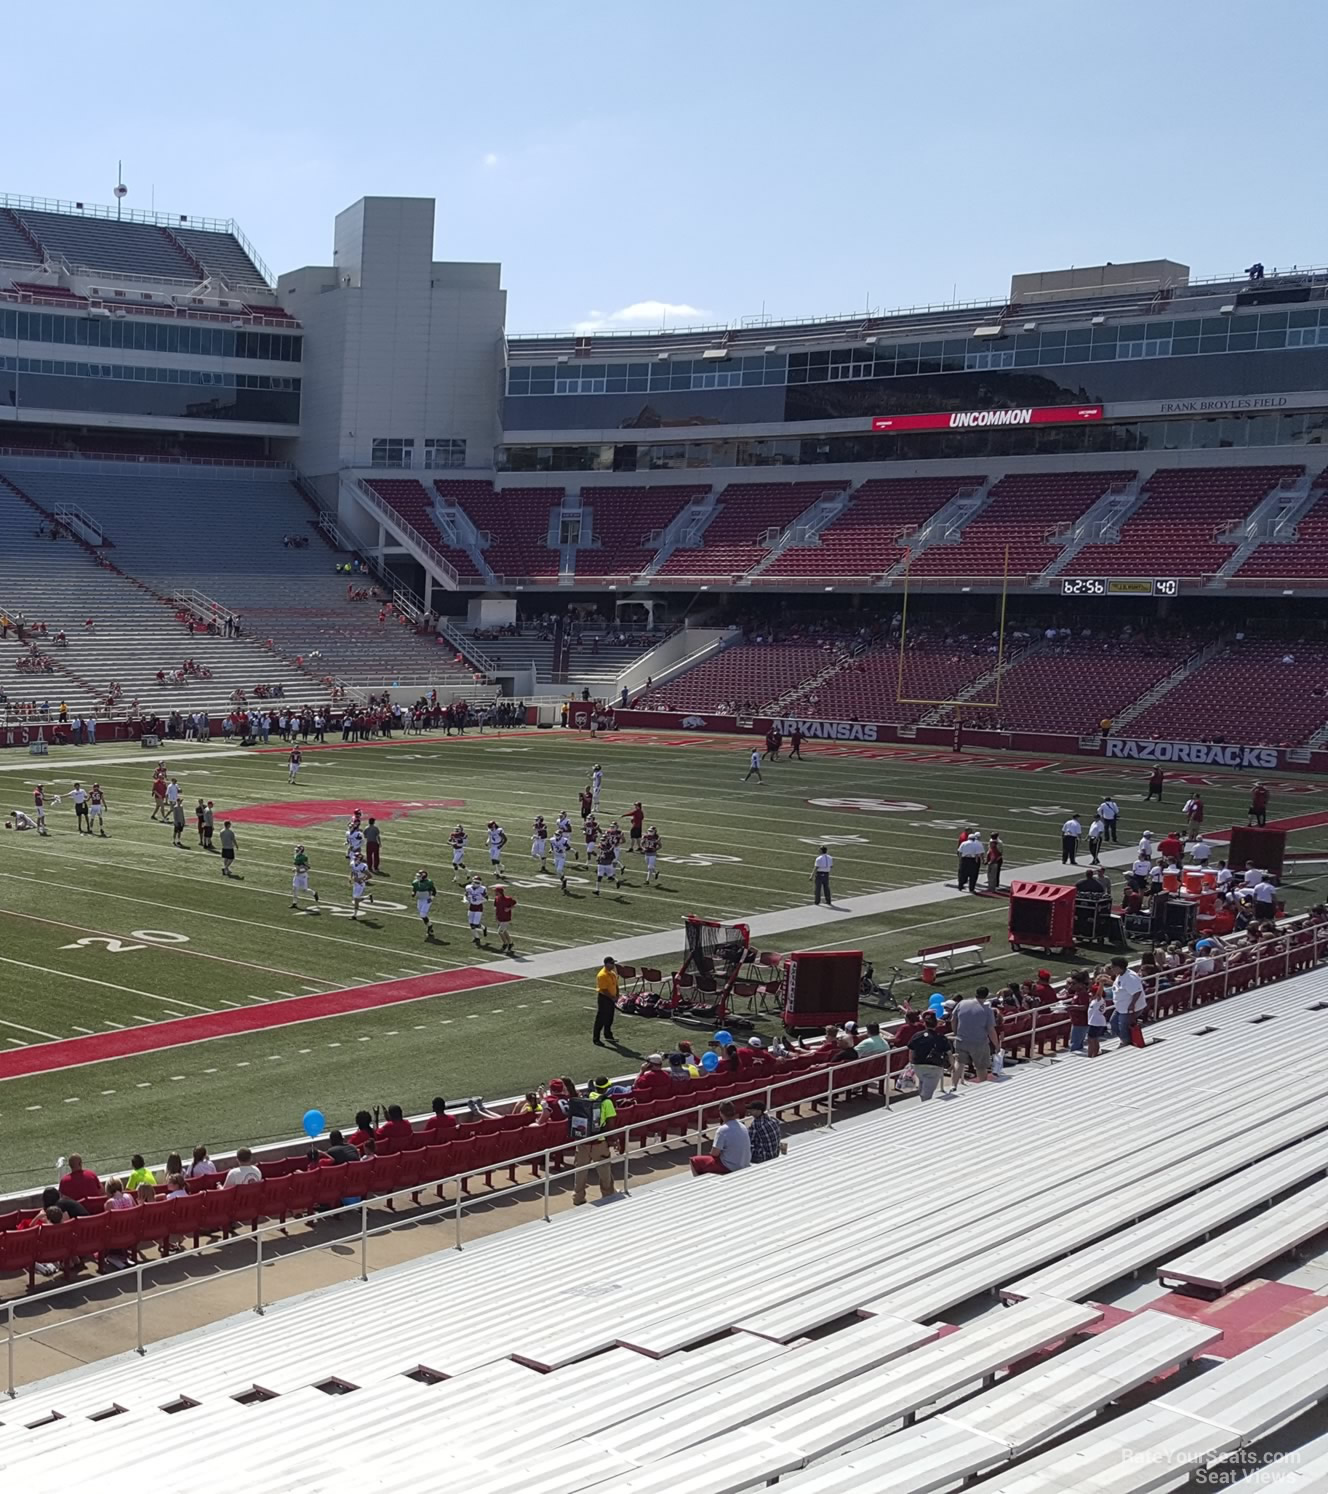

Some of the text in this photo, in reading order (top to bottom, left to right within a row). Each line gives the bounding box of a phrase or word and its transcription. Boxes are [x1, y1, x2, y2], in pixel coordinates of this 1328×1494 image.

[1160, 397, 1288, 413] FRANK BROYLES FIELD
[949, 409, 1032, 427] UNCOMMON
[1156, 581, 1176, 594] 40
[772, 719, 878, 741] ARKANSAS
[1105, 738, 1278, 769] RAZORBACKS
[656, 852, 743, 867] 50
[510, 874, 591, 888] 40
[305, 900, 409, 918] 30
[73, 929, 191, 953] 20
